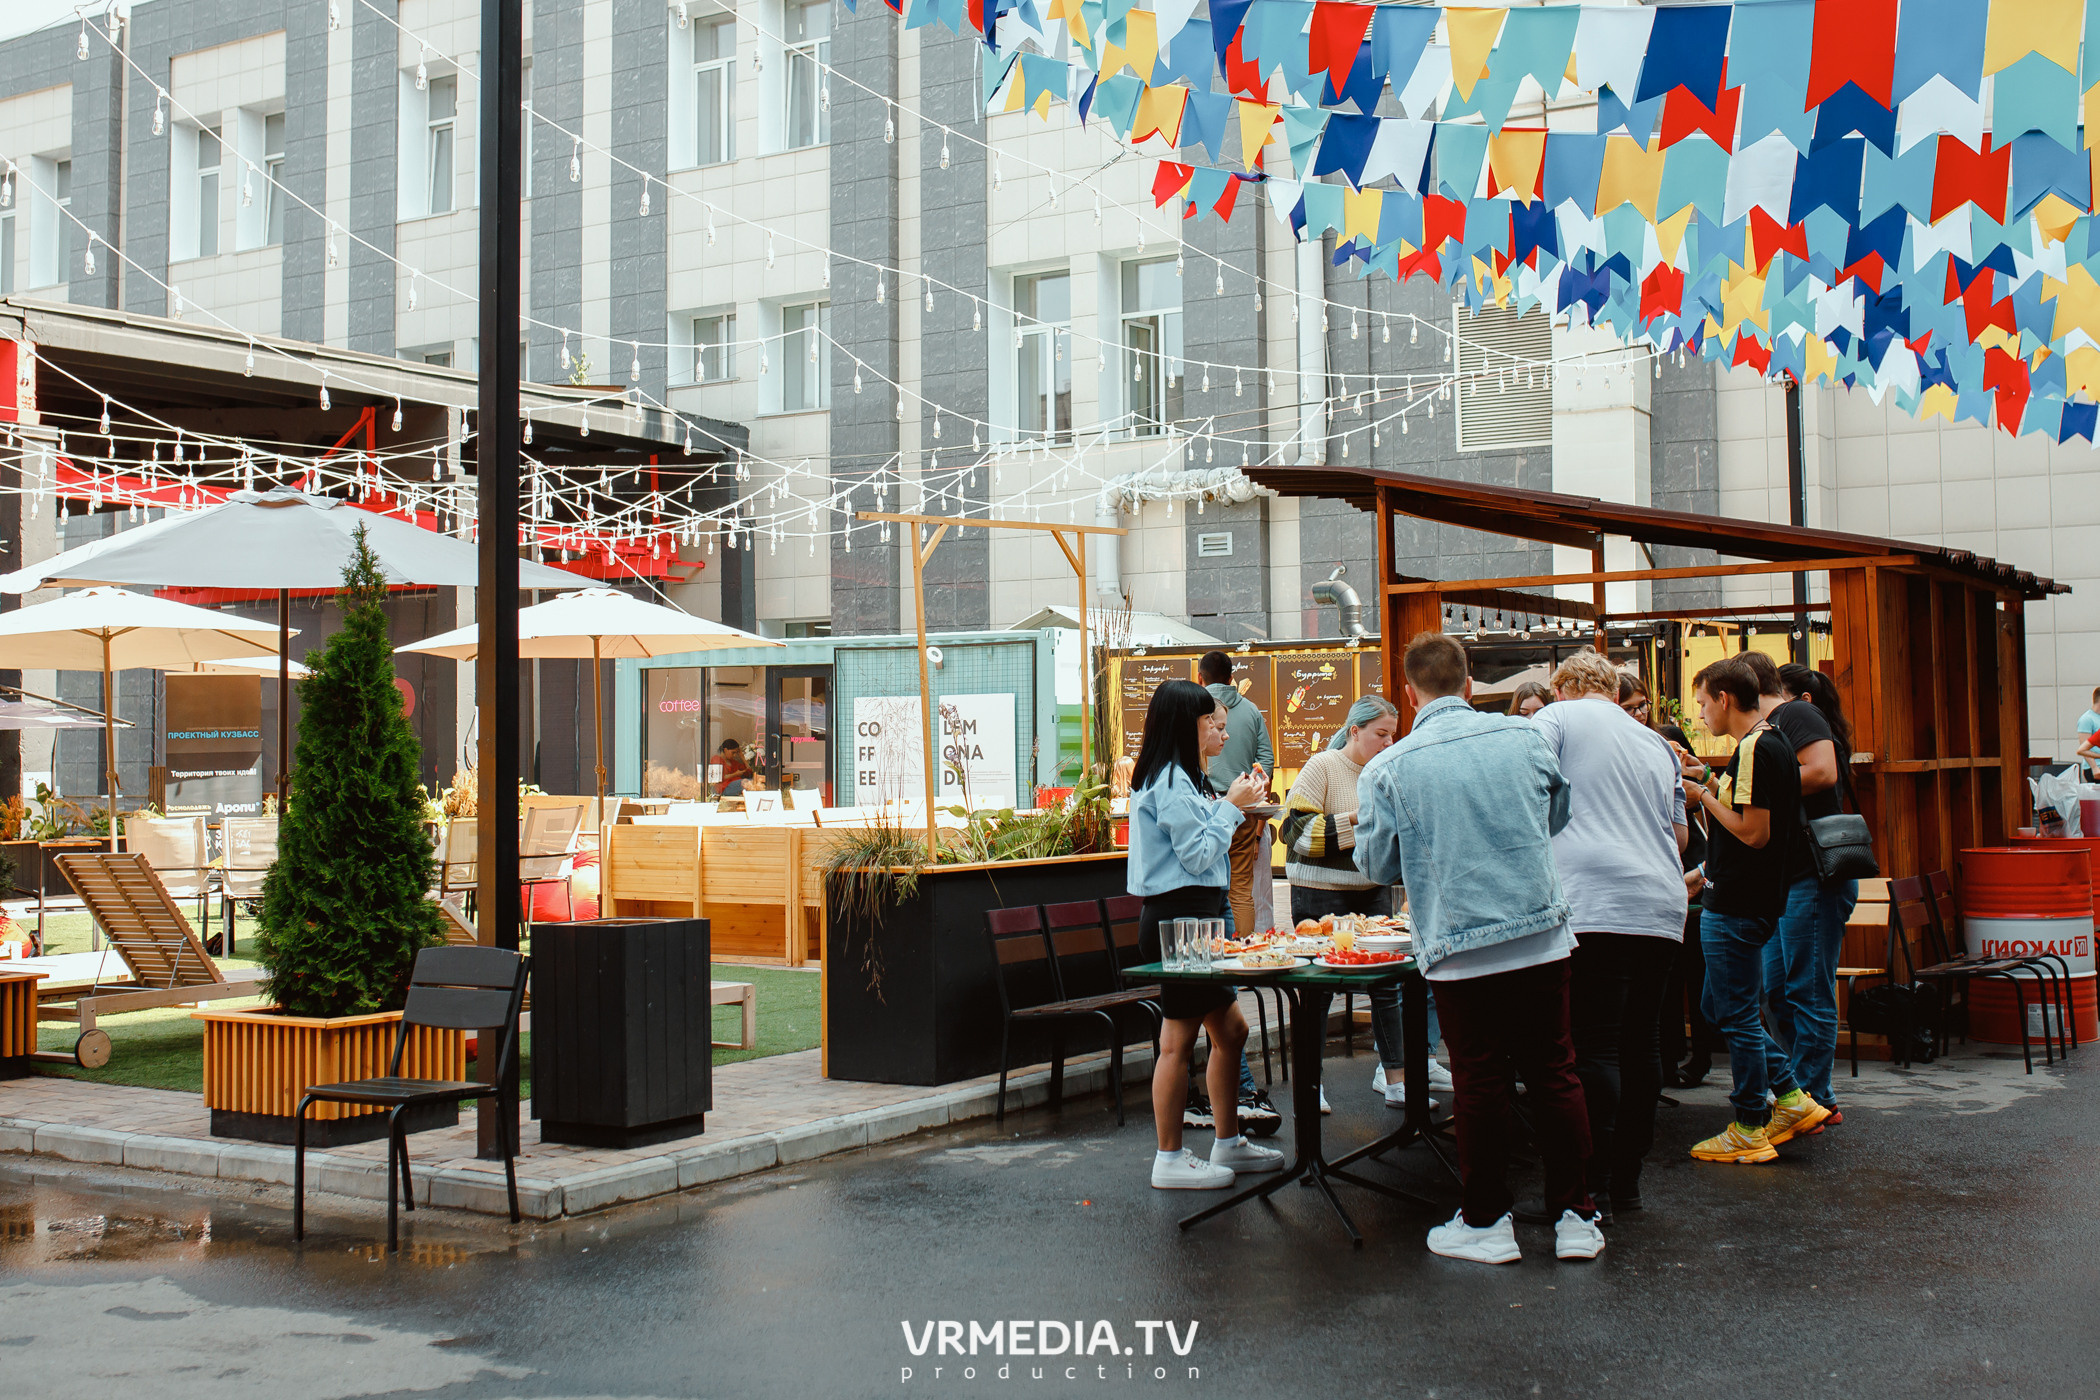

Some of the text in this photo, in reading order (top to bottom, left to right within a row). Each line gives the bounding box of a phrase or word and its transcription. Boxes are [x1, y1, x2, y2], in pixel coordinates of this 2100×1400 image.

[659, 699, 701, 712] coffee
[167, 730, 259, 739] ПРОЕКТНЫЙ КУЗБАСС
[858, 721, 881, 737] CO
[859, 746, 875, 761] FF
[943, 744, 984, 760] ONA
[170, 770, 214, 778] Территория
[859, 771, 876, 785] EE
